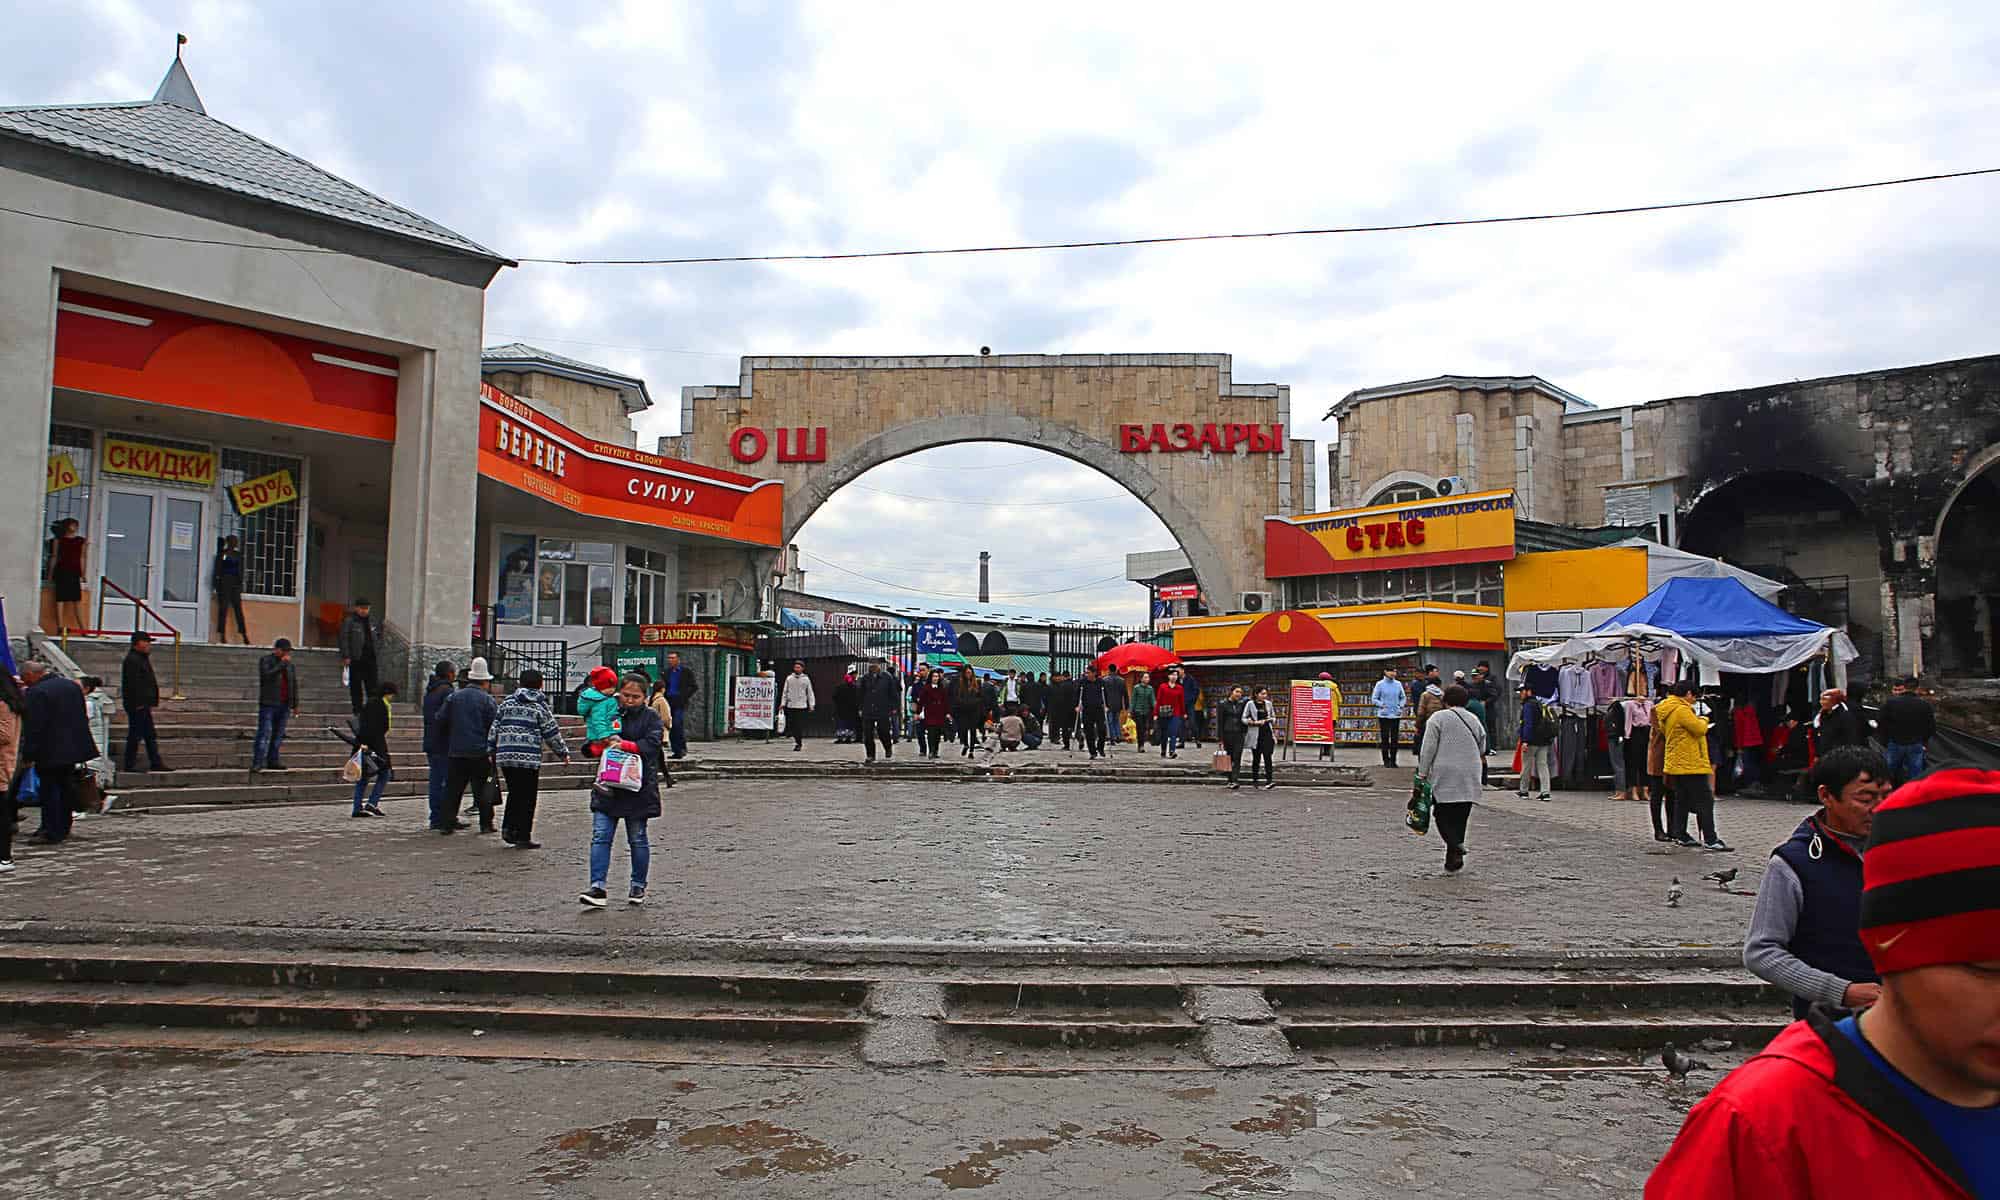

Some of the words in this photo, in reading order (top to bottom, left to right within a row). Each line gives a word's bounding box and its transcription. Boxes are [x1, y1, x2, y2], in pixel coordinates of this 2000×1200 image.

[498, 419, 566, 477] БЕРЕКЕ
[728, 426, 828, 464] ОШ
[1119, 422, 1284, 454] БАЗАРЫ
[108, 445, 212, 481] СКИДКИ
[239, 478, 292, 510] 50%
[627, 477, 696, 505] СУЛУУ
[1398, 498, 1514, 522] ПАРИКМАХЕРСКАЯ
[1345, 518, 1425, 551] СТАС
[659, 629, 718, 641] ГАМБУРГЕР
